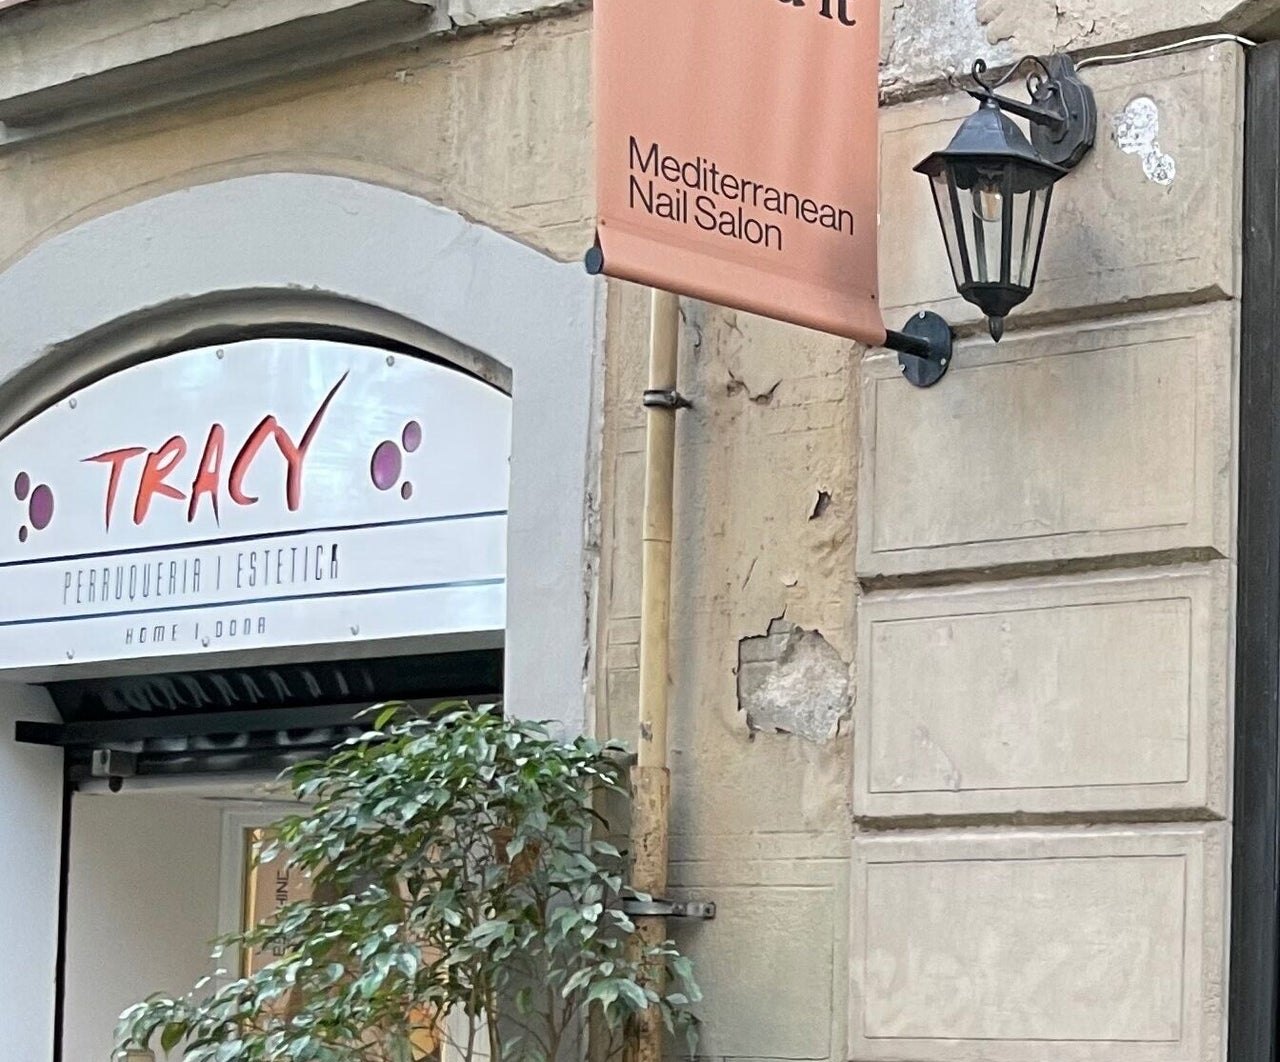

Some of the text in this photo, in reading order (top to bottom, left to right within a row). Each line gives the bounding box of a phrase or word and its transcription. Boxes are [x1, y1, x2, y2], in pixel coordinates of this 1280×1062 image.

[629, 135, 854, 236] Mediterranean
[629, 174, 782, 250] Nail Salon
[79, 369, 350, 534] TRACY
[63, 557, 202, 605] PERRUQUERIA
[236, 543, 339, 588] ESTETICA
[125, 624, 178, 644] HOME
[216, 616, 266, 638] DONA
